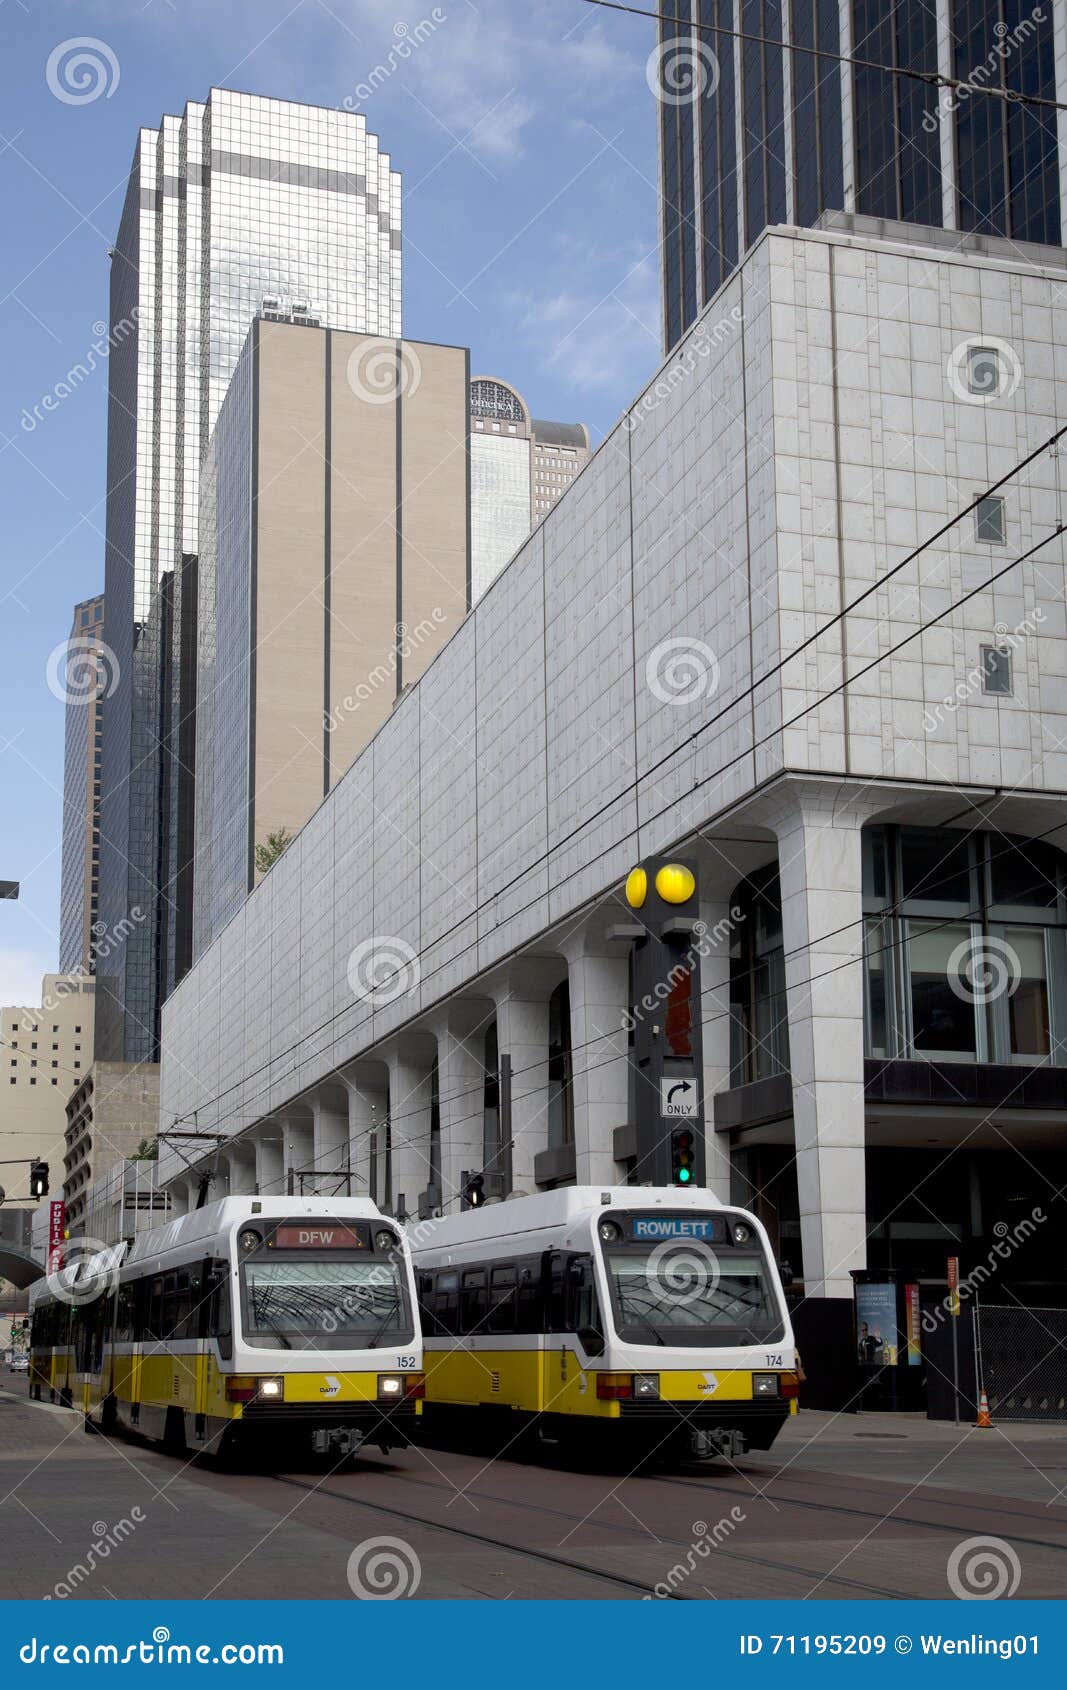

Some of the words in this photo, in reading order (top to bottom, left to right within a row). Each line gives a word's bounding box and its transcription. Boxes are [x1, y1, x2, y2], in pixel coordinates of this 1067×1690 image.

[667, 1104, 692, 1115] ONLY
[53, 1204, 62, 1245] PUBLIC
[637, 1222, 709, 1236] ROWLETT
[299, 1231, 334, 1244] DFW
[397, 1357, 416, 1368] 152
[765, 1355, 783, 1366] 174
